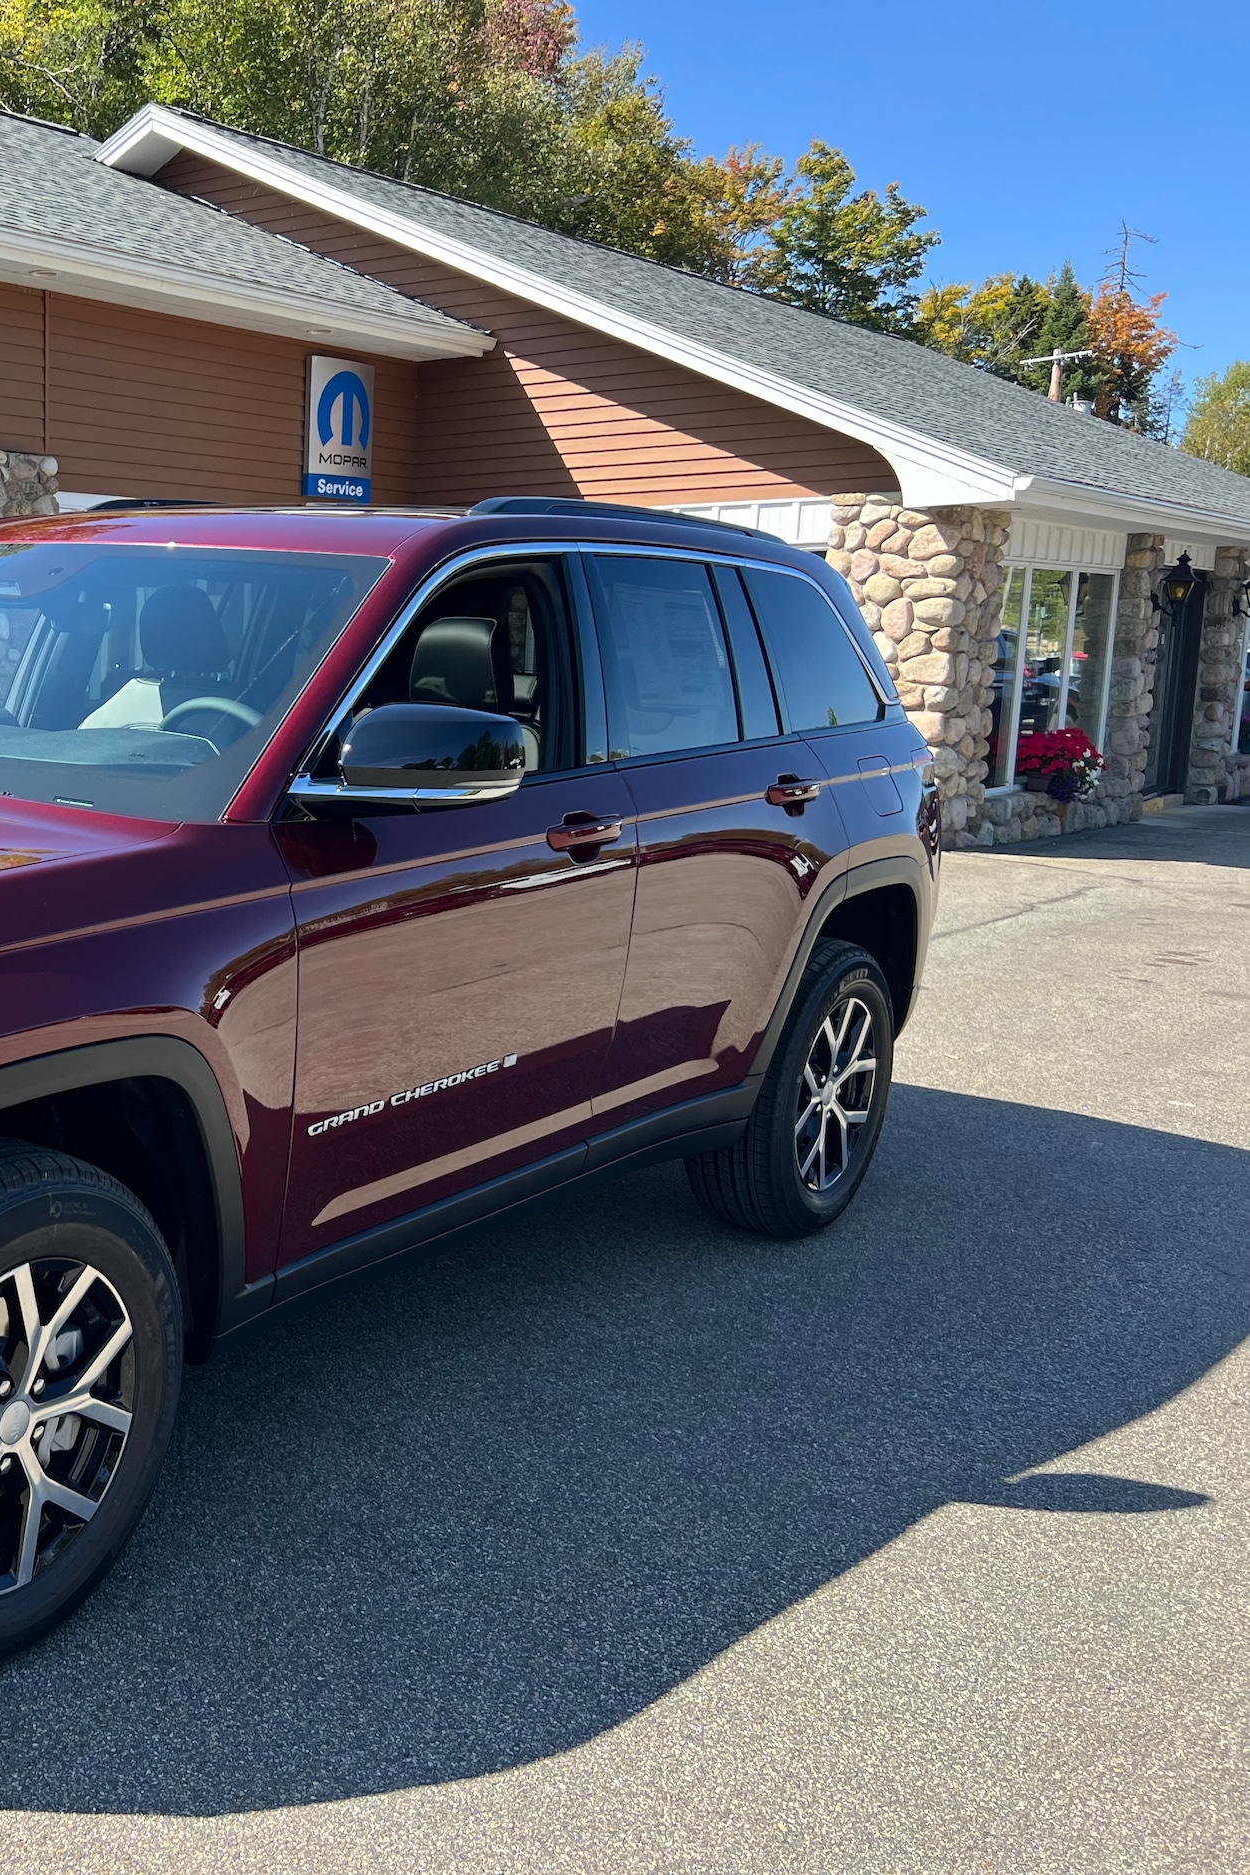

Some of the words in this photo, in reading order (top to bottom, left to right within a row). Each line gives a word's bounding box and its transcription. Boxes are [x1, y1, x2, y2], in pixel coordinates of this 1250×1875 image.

[318, 453, 368, 468] MOPAR
[317, 478, 363, 497] Service
[307, 1100, 385, 1137] GRAND
[390, 1059, 501, 1107] CHEROKEE
